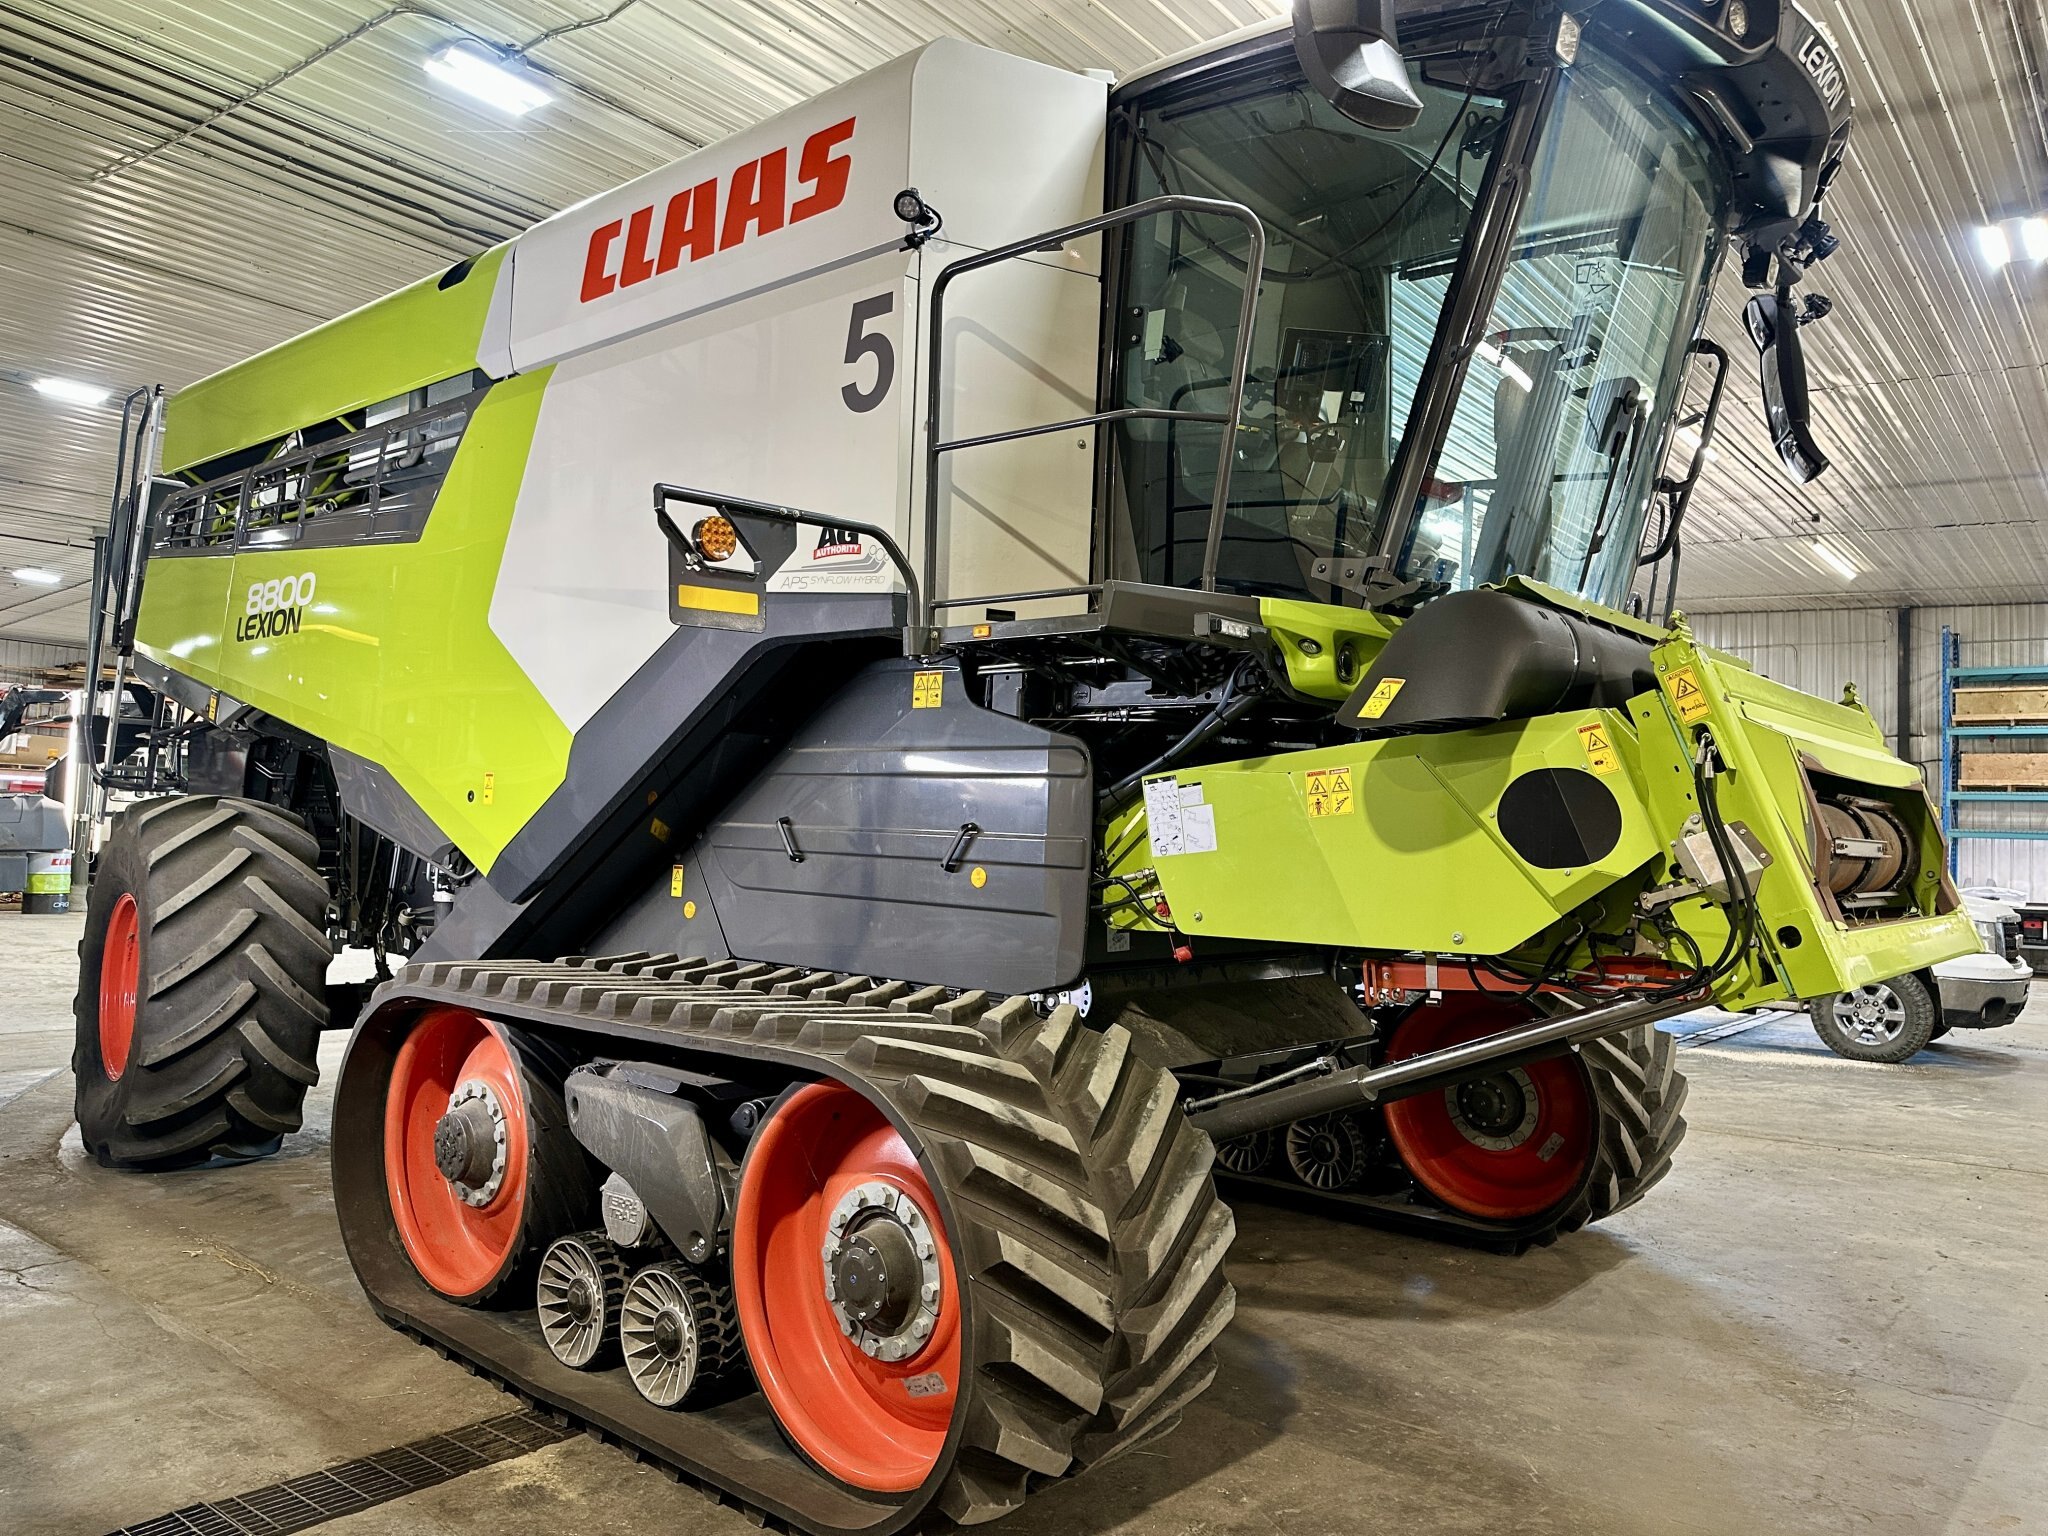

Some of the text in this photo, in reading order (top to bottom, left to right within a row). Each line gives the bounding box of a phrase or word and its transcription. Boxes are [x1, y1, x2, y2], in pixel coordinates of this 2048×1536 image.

[1798, 34, 1846, 112] LEXION
[580, 116, 856, 304] CLAAS
[841, 291, 895, 413] 5
[815, 545, 860, 558] AUTHORITY
[816, 526, 860, 550] AG
[245, 571, 317, 616] 8800
[780, 575, 886, 590] APS SYNFLOW HYBRID
[236, 605, 303, 642] LEXION
[606, 1191, 641, 1212] TERRA
